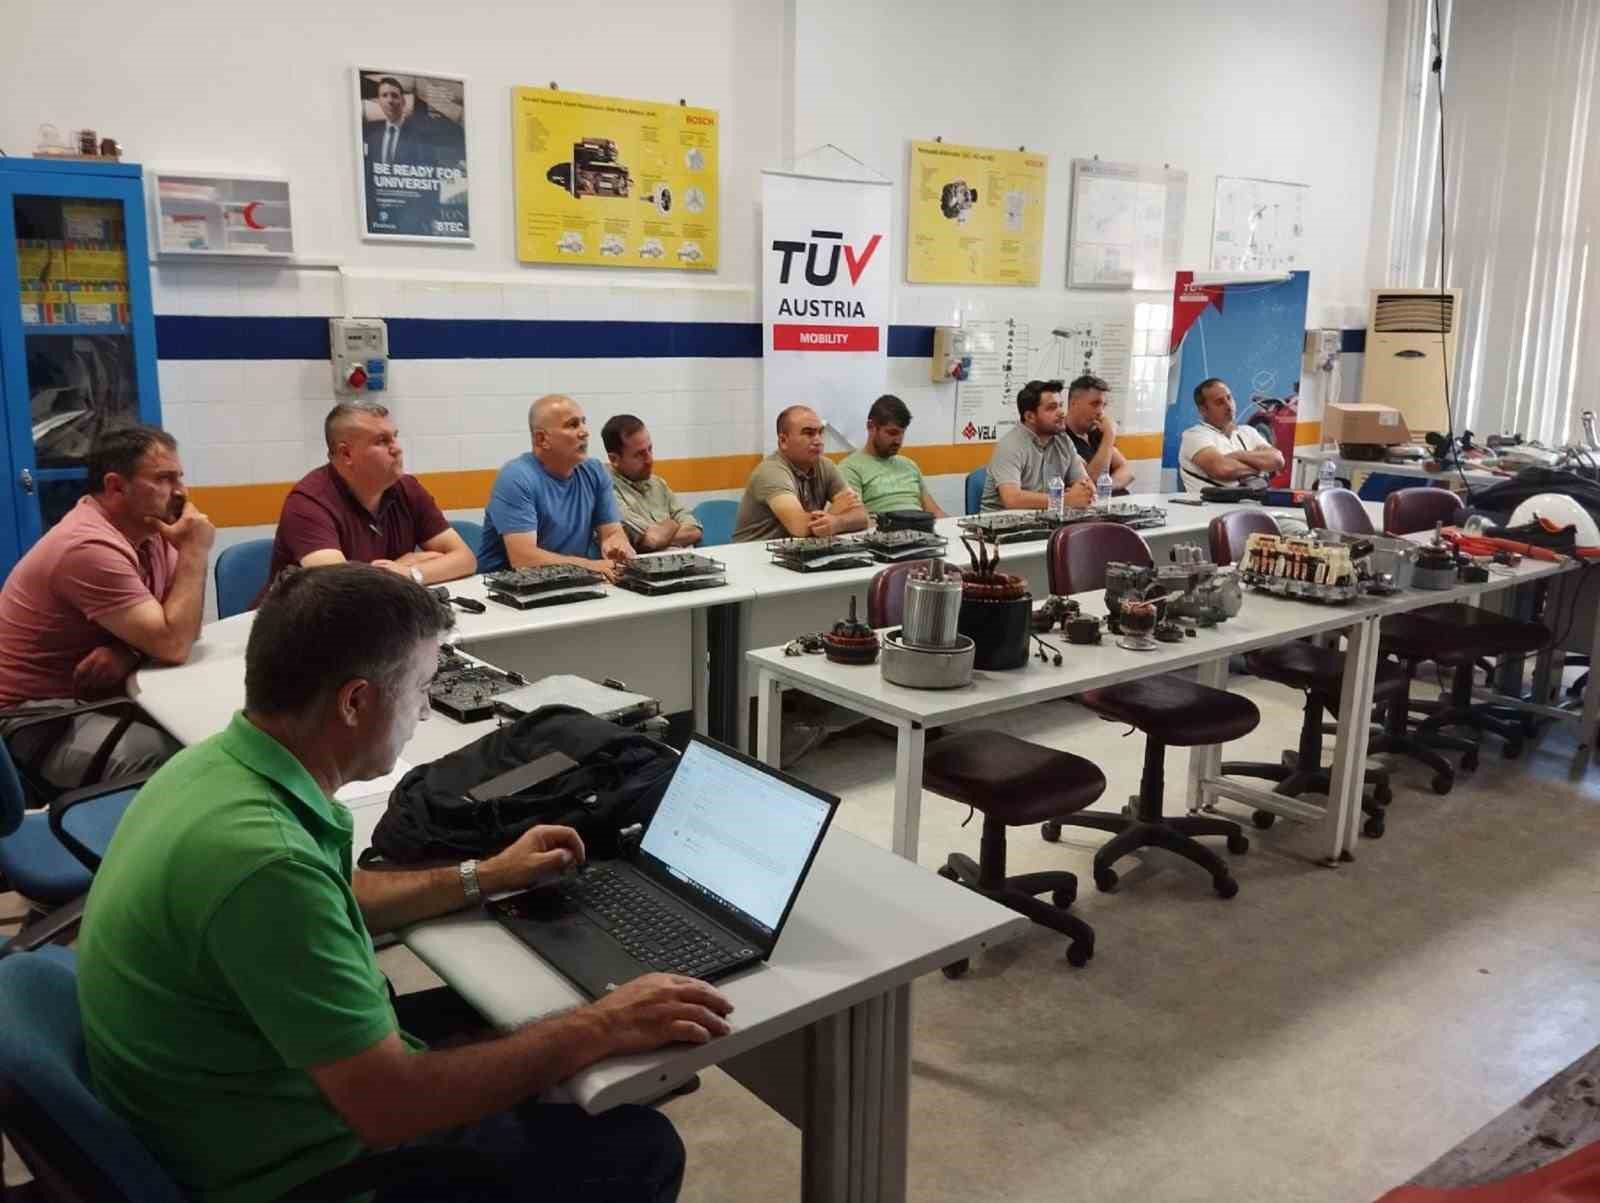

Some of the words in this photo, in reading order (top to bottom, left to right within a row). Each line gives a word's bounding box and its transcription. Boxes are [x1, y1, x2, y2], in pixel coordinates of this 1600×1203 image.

[373, 162, 391, 175] BE
[393, 164, 434, 178] READY
[436, 167, 461, 179] FOR
[434, 220, 464, 232] BTEC
[778, 298, 865, 318] AUSTRIA
[800, 333, 848, 344] MOBILITY
